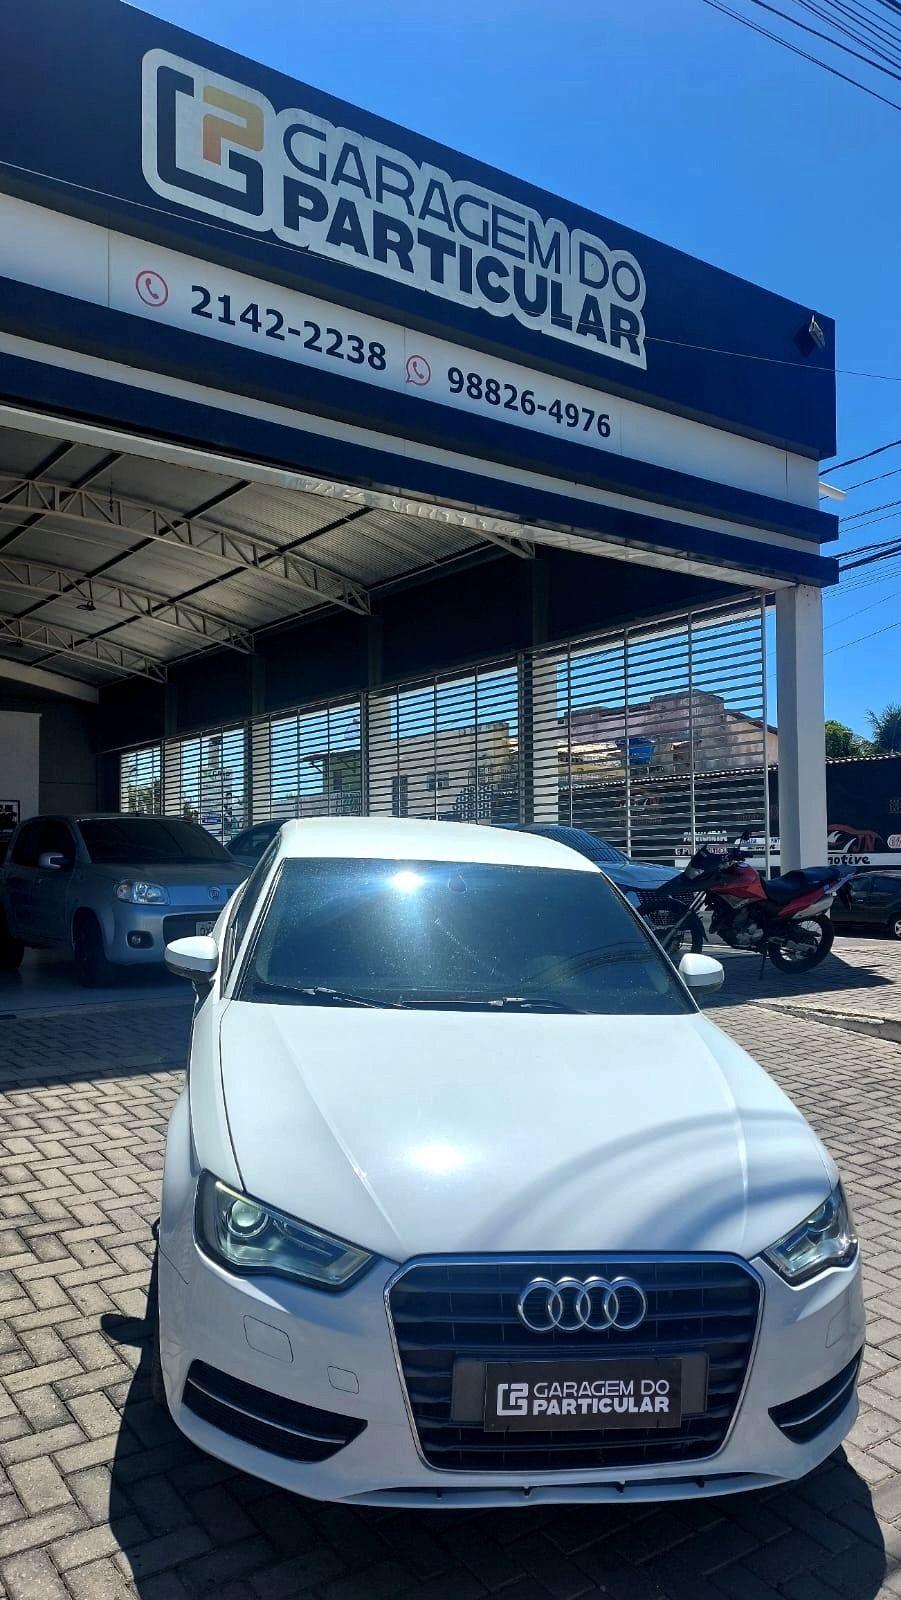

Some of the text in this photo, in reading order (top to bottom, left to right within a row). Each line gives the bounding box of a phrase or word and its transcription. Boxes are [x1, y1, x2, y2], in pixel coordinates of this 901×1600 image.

[282, 122, 641, 303] GARAGEM DO
[282, 175, 641, 357] PARTICULAR
[190, 285, 387, 371] 2142-2238
[446, 366, 612, 438] 98826-4976
[532, 1396, 670, 1416] PARTICULAR
[533, 1379, 670, 1398] GARAGEM DO
